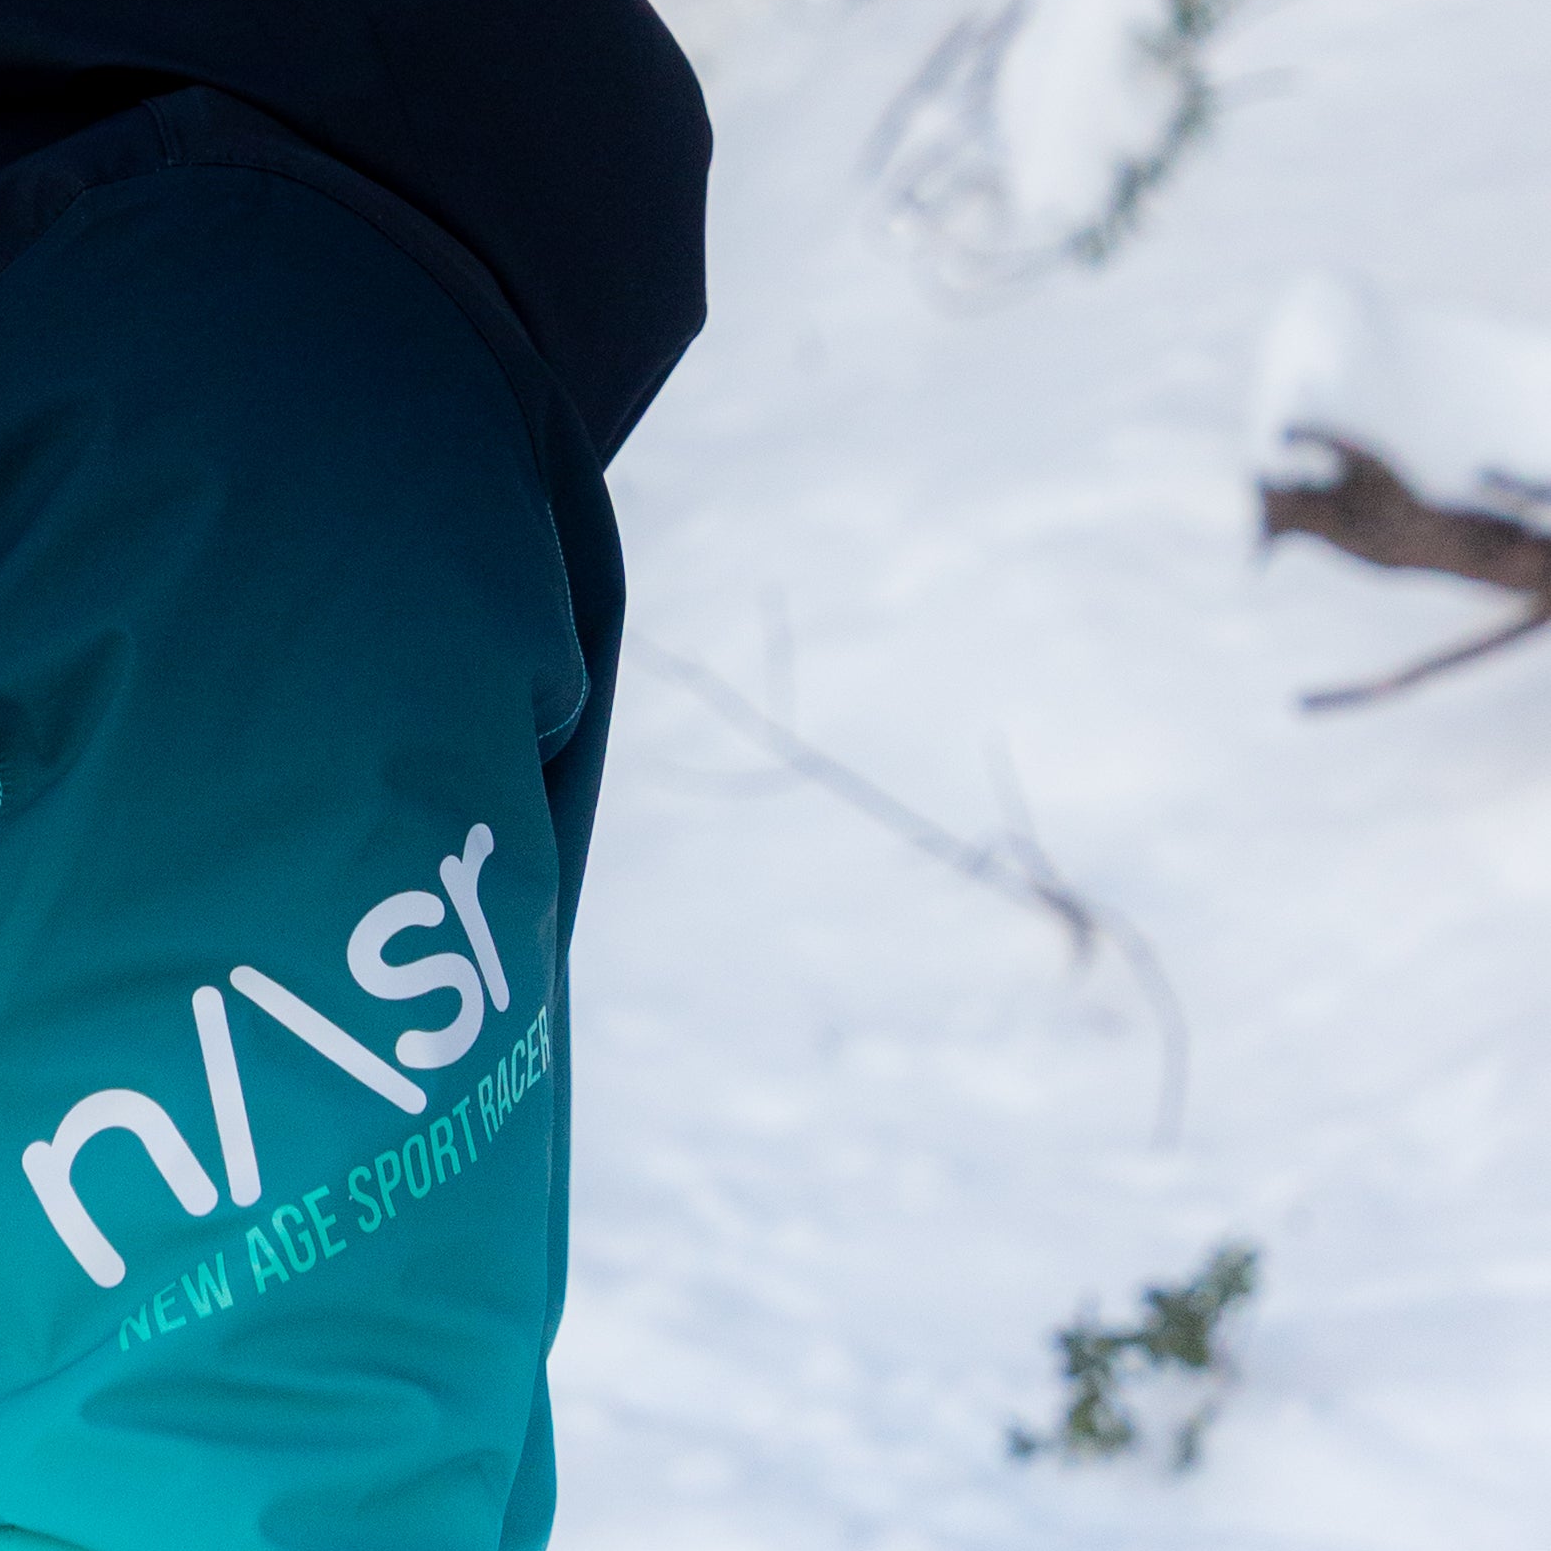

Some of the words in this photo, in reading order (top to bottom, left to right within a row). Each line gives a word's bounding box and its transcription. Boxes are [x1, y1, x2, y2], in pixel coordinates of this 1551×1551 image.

[118, 1251, 234, 1352] NEW
[245, 1184, 347, 1295] AGE
[348, 1095, 478, 1233] SPORT
[477, 1004, 551, 1143] RACER
